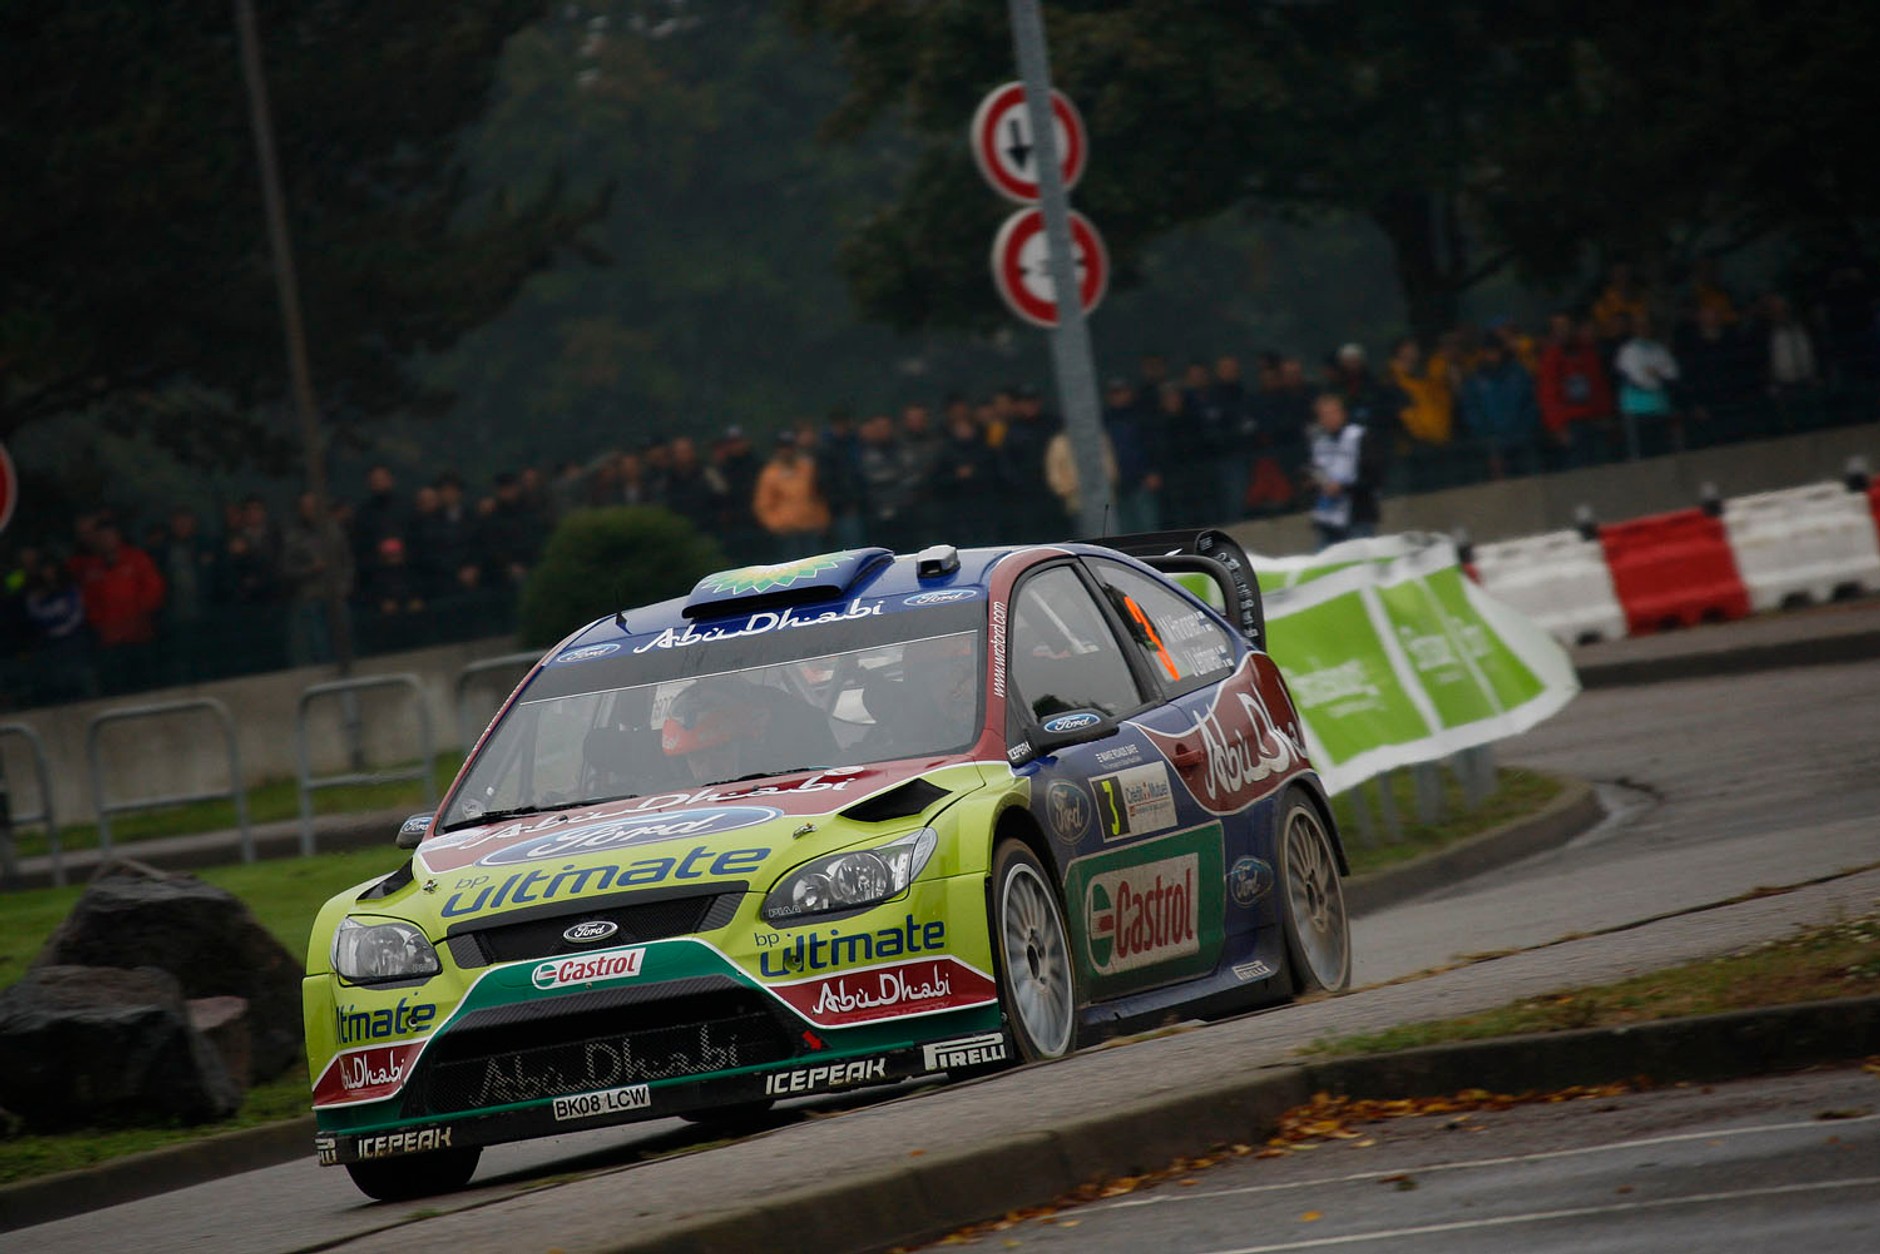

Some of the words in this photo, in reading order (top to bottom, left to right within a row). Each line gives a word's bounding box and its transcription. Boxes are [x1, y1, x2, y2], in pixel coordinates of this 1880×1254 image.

[916, 591, 965, 604] Ford
[566, 645, 611, 661] Ford
[1055, 716, 1091, 731] Ford
[1053, 790, 1083, 833] Ford
[527, 813, 727, 857] Ford
[441, 846, 771, 918] ultimate
[455, 875, 489, 889] bp
[1115, 868, 1193, 958] Castrol
[574, 923, 604, 938] Ford
[754, 932, 780, 948] bp
[761, 914, 945, 977] ultimate
[559, 952, 636, 982] Castrol
[923, 1032, 1006, 1071] PIRELLI
[765, 1057, 886, 1095] ICEPEAK
[556, 1095, 601, 1118] BK08
[608, 1088, 647, 1111] LCW
[359, 1127, 452, 1159] ICEPEAK
